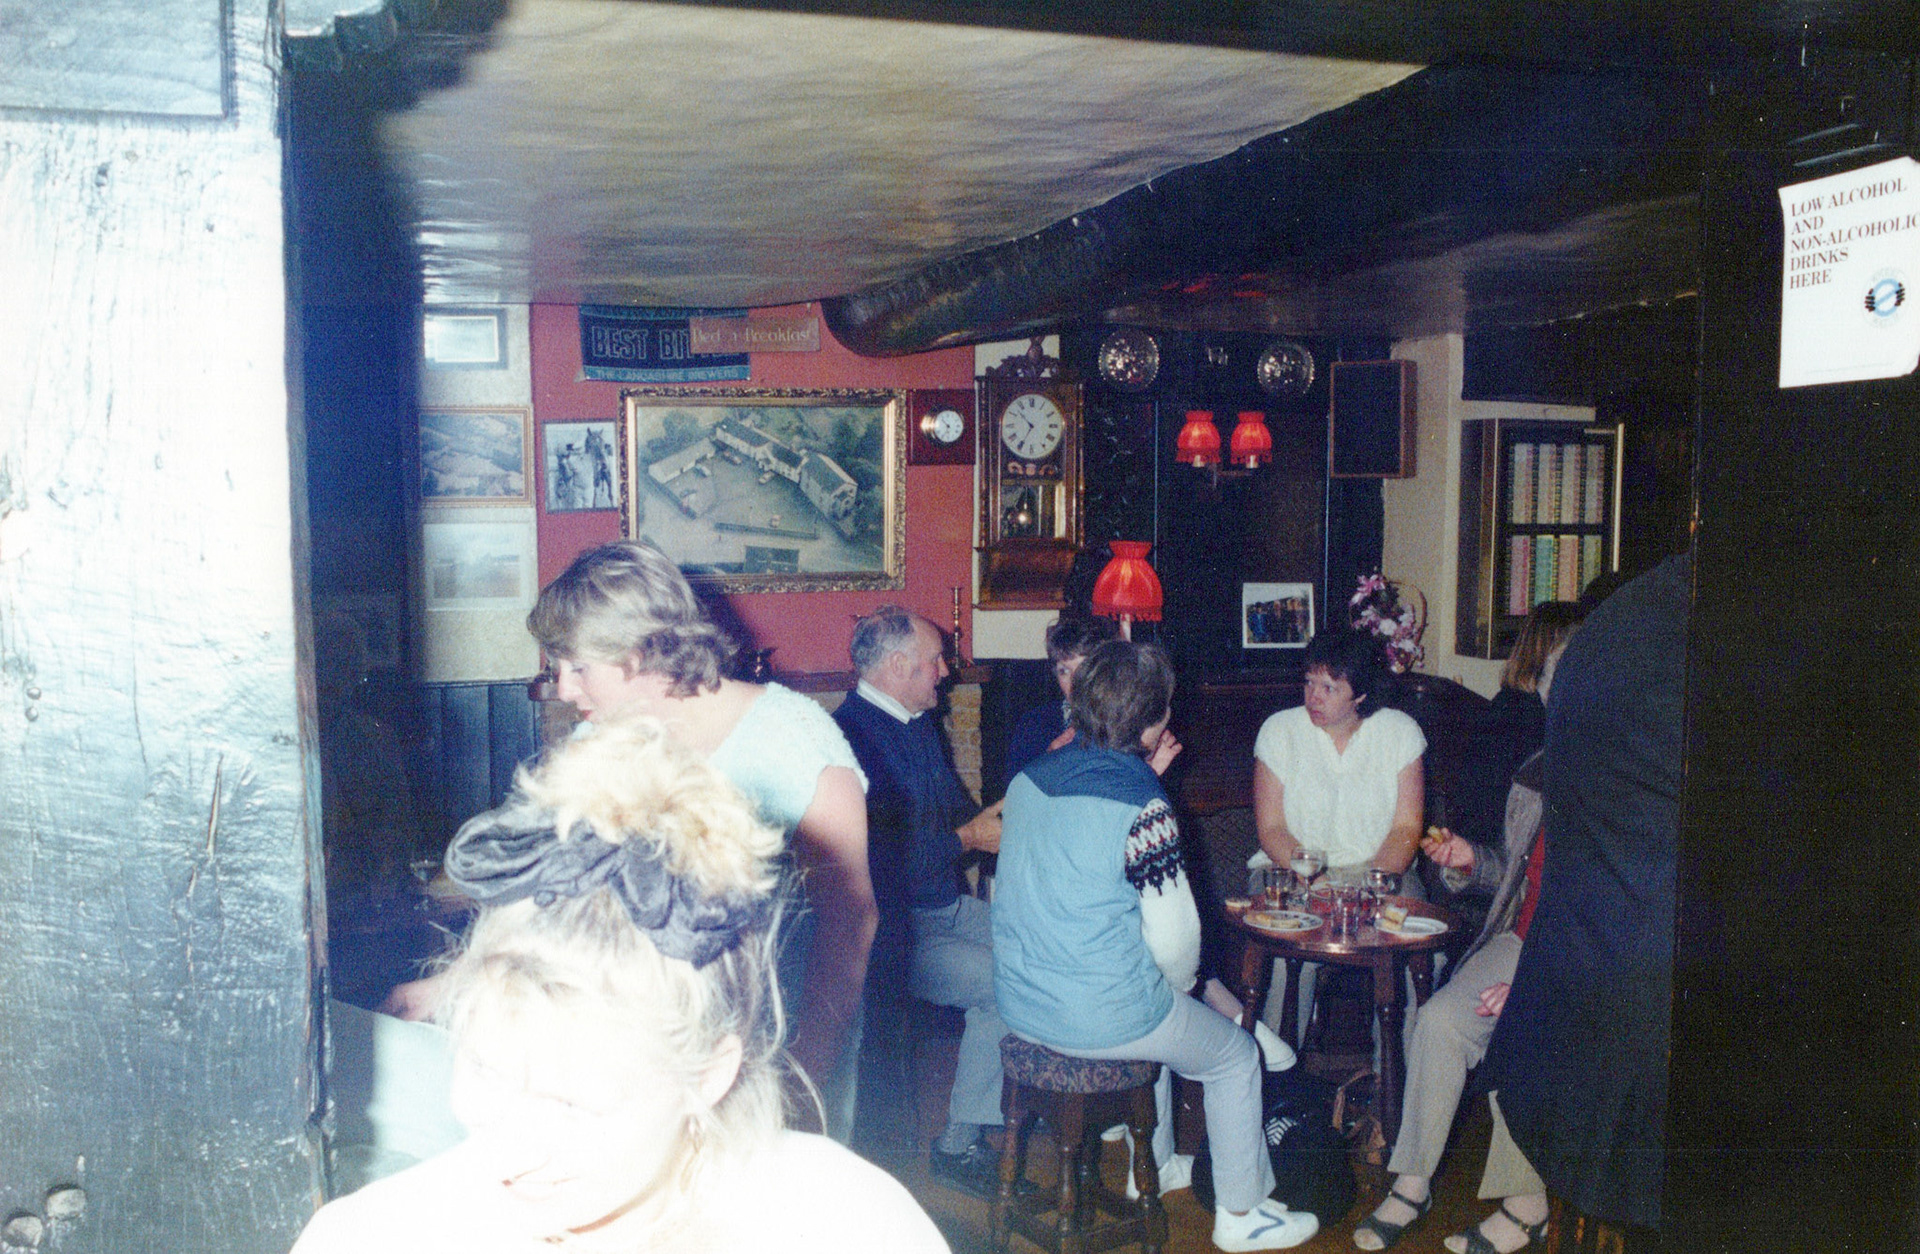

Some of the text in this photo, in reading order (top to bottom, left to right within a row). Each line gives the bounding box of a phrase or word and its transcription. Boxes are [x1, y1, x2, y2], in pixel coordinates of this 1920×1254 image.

[1791, 178, 1907, 217] LOW ALCOHOL
[1791, 216, 1824, 235] AND
[1790, 247, 1849, 271] DRINKS
[1789, 269, 1832, 289] HERE
[591, 326, 649, 360] BEST
[692, 328, 720, 342] Bed
[745, 327, 811, 342] Breakfast
